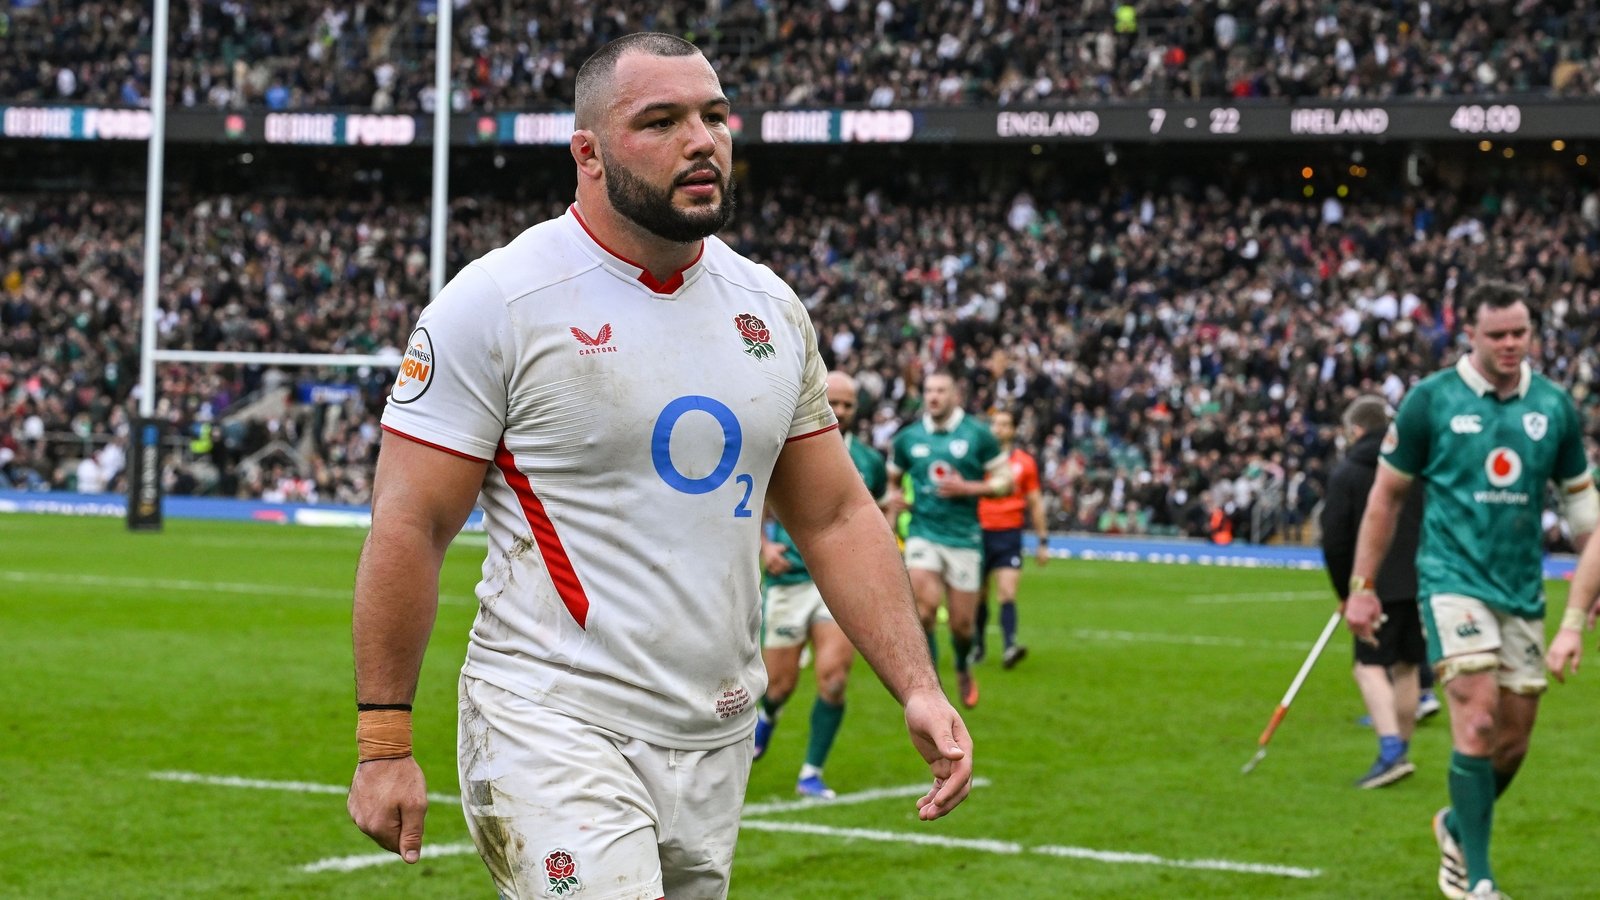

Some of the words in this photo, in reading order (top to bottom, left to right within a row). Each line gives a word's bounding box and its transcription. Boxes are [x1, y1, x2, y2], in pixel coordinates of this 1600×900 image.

[83, 107, 150, 140] FORD
[345, 113, 416, 145] FORD
[840, 109, 914, 143] FORD
[997, 110, 1099, 137] ENGLAND
[1148, 108, 1167, 134] 7
[1209, 107, 1240, 134] 22
[1290, 107, 1389, 135] IRELAND
[1450, 104, 1521, 134] 40:00
[579, 346, 618, 356] CASTORE
[651, 395, 754, 518] O2
